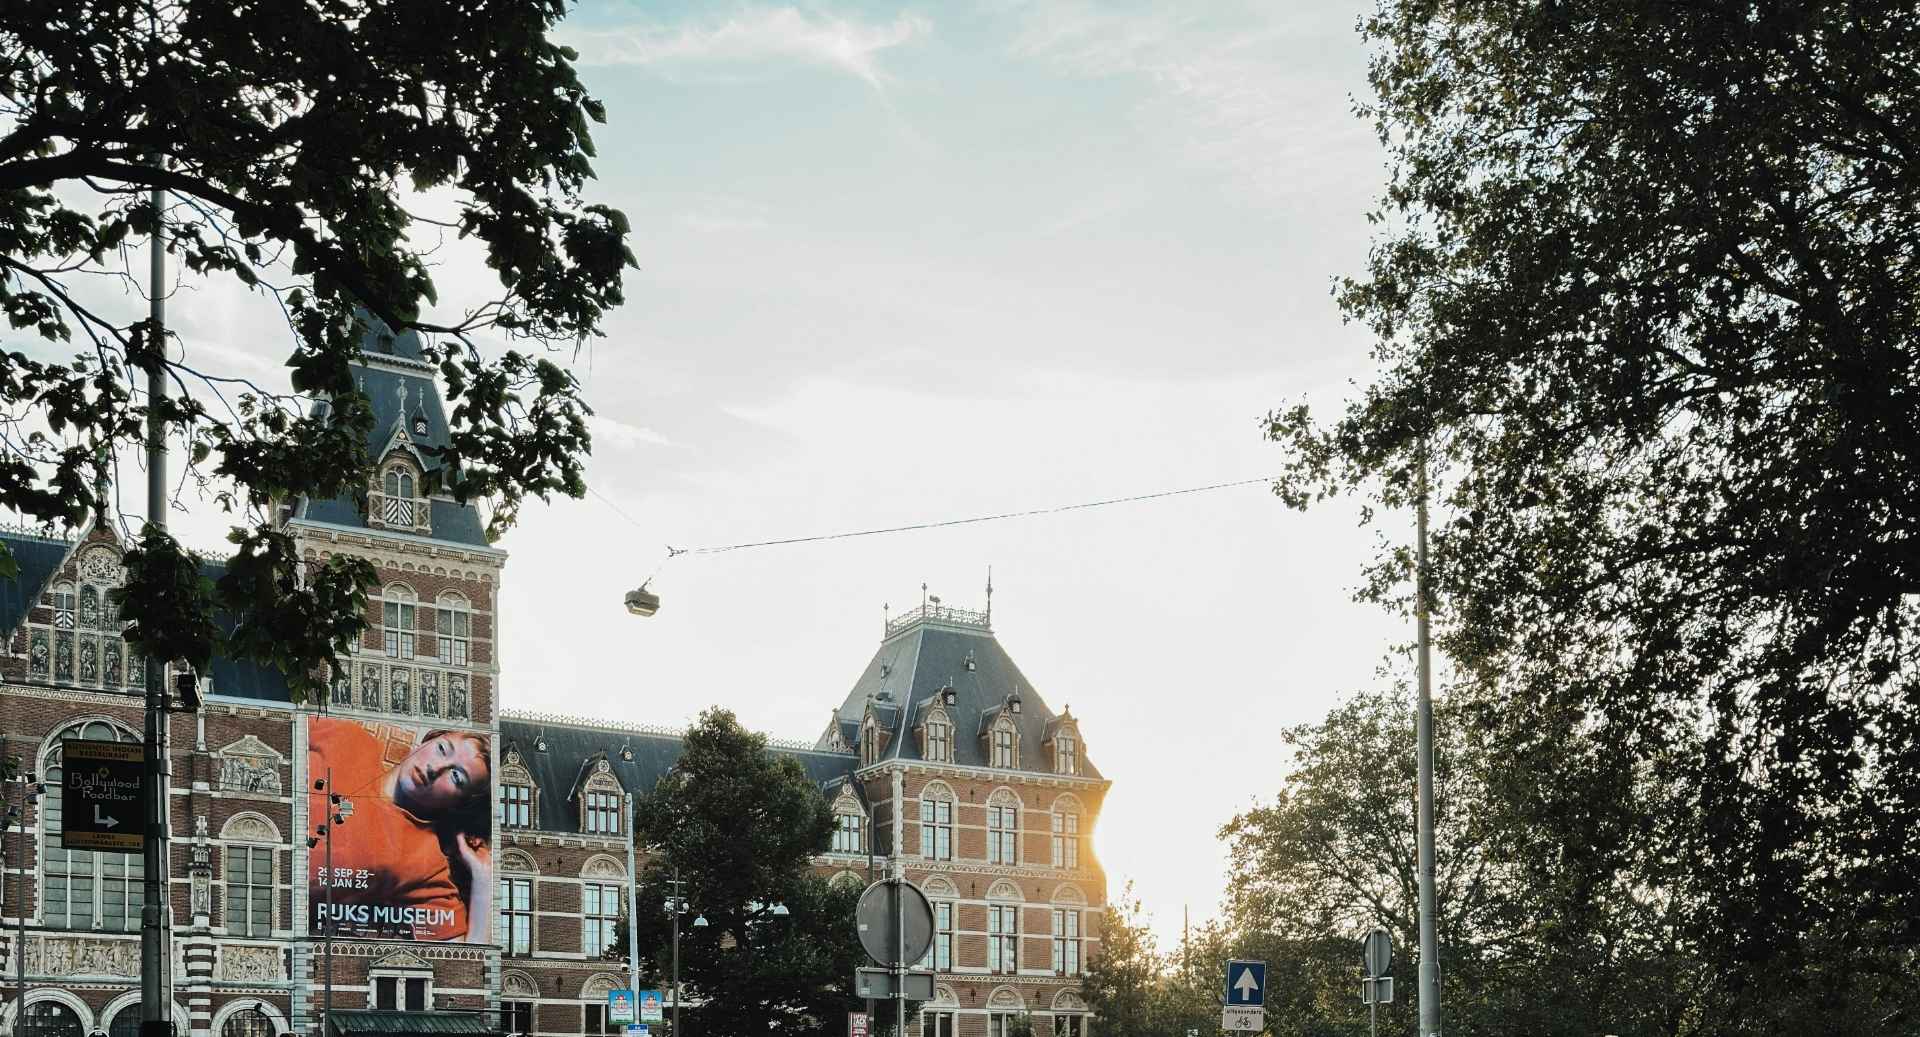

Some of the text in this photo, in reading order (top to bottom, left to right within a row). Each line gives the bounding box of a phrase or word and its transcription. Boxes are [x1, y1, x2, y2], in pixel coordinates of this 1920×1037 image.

[68, 772, 140, 791] Bollywood
[82, 785, 136, 801] Foodbar
[334, 868, 353, 878] SEP
[331, 878, 352, 888] JAN
[355, 879, 368, 888] 24
[317, 903, 455, 926] RIJKS MUSEUM
